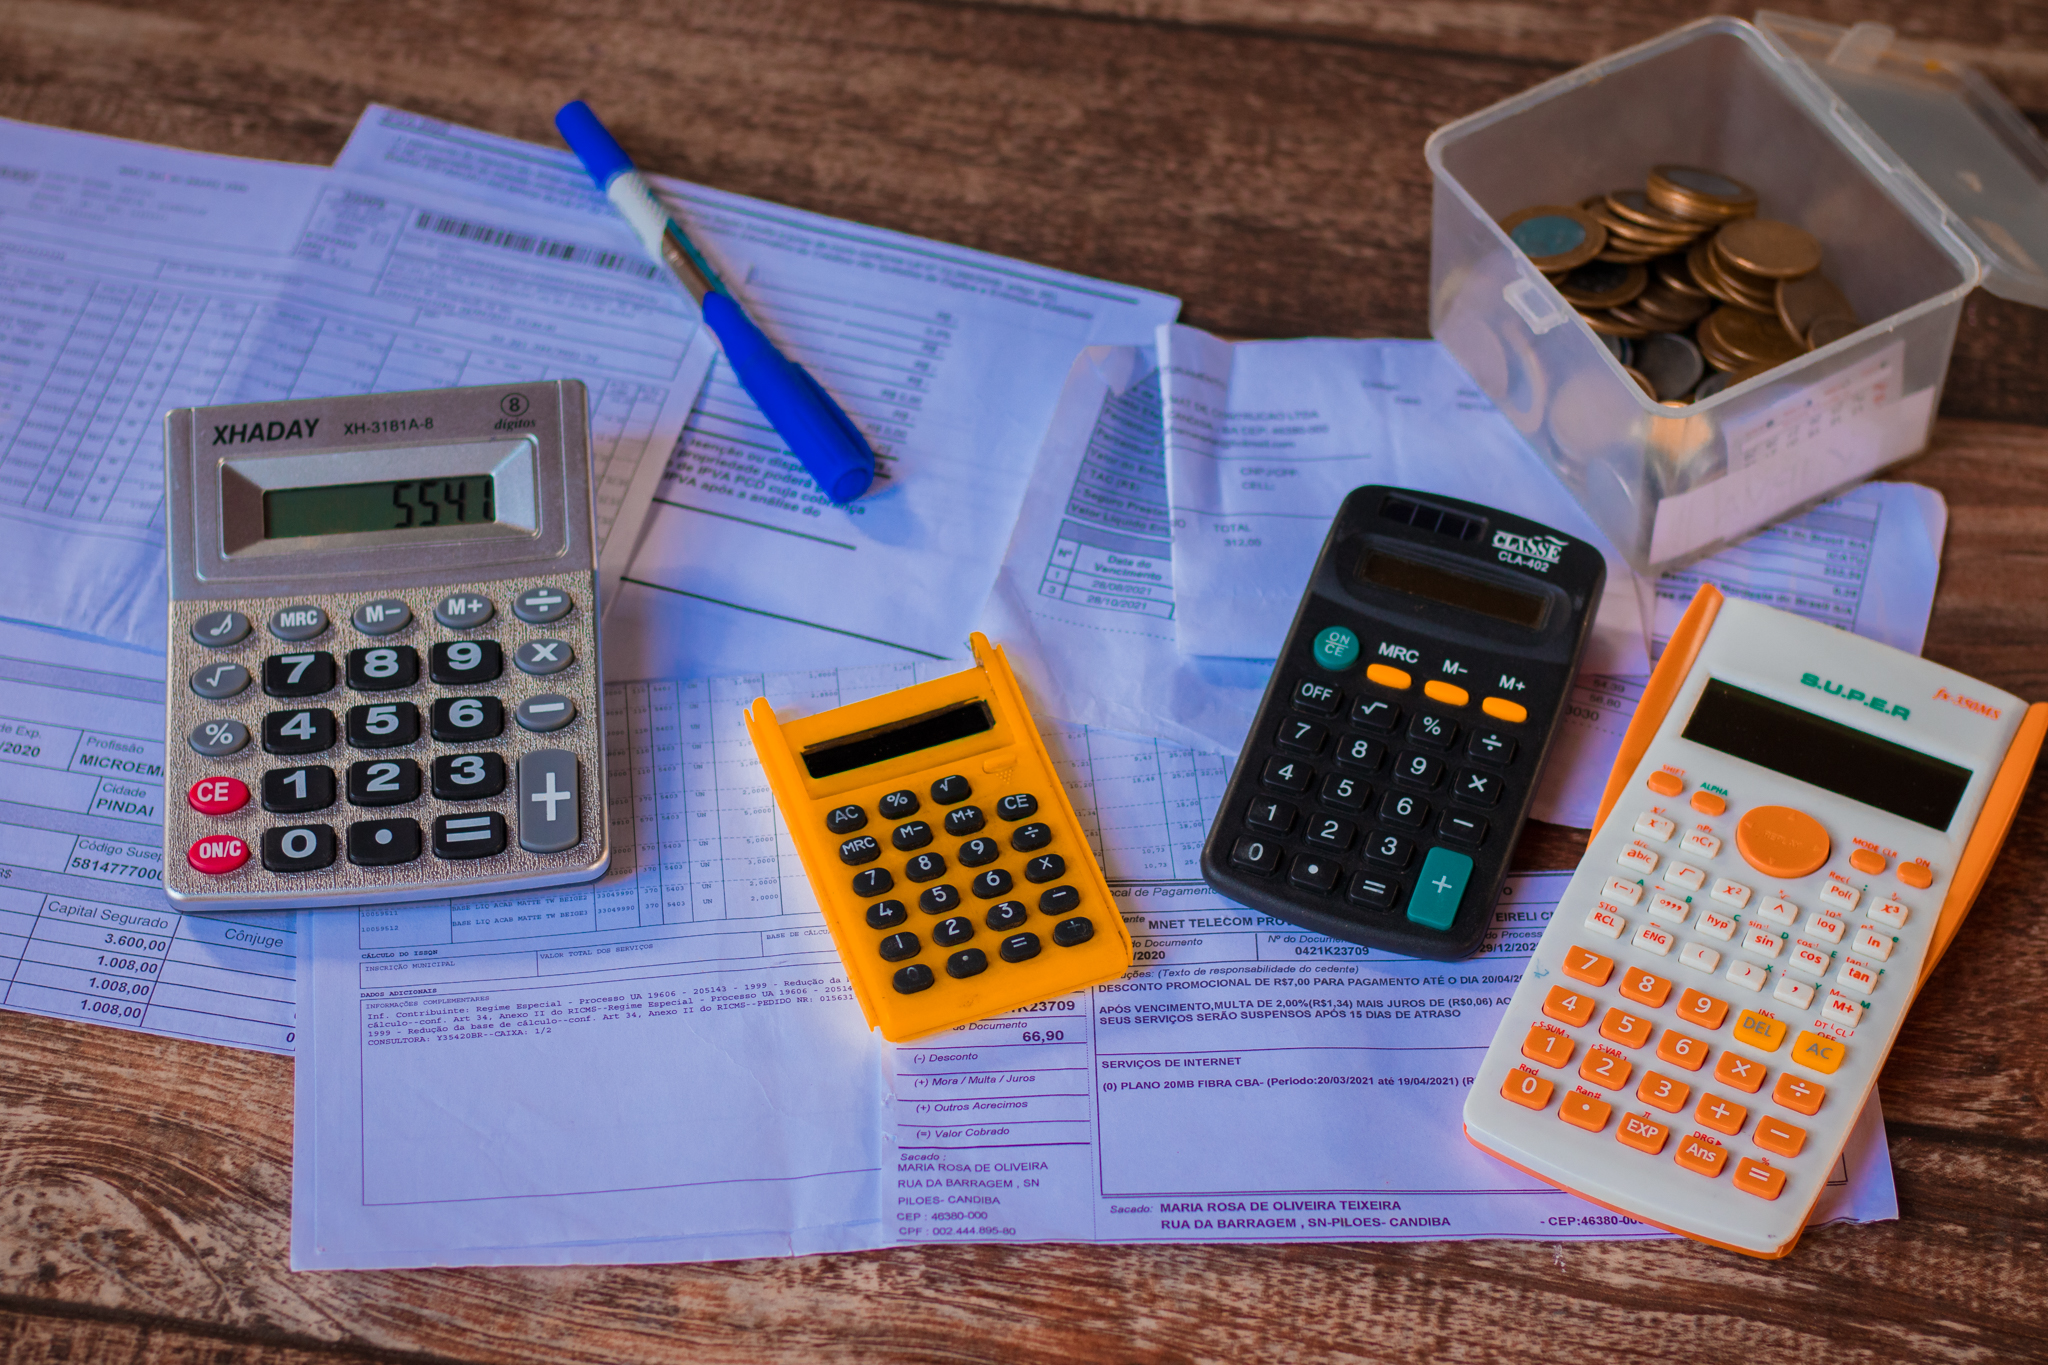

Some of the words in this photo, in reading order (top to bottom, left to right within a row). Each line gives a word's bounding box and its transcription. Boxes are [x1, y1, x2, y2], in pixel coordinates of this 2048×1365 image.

[212, 418, 319, 446] XHADAY
[344, 418, 434, 435] XH-3181A-8
[393, 477, 496, 529] 5541
[1498, 551, 1549, 572] CLA-402
[280, 610, 317, 627] MRC
[448, 598, 482, 616] M+
[1329, 632, 1350, 645] ON
[1325, 644, 1343, 657] CE
[281, 654, 315, 684] 7
[363, 649, 399, 678] 8
[447, 642, 482, 671] 9
[1378, 642, 1419, 664] MRC
[1499, 675, 1525, 691] M+
[1302, 683, 1333, 701] OFF
[280, 712, 316, 741] 4
[365, 706, 399, 735] 5
[448, 699, 485, 728] 6
[197, 781, 229, 802] CE
[282, 770, 307, 799] 1
[366, 764, 400, 793] 2
[450, 755, 486, 786] 3
[1662, 764, 1686, 776] SHIFT
[1700, 782, 1728, 796] ALPHA
[103, 783, 147, 798] Cidade
[96, 798, 154, 817] PINDAI
[834, 807, 859, 823] AC
[1004, 795, 1029, 810] CE
[79, 839, 122, 856] Código
[200, 840, 241, 860] ON/C
[281, 829, 317, 859] 0
[842, 837, 875, 856] MRC
[1852, 837, 1879, 853] MODE
[1882, 848, 1897, 858] CLR
[1915, 858, 1931, 868] ON
[48, 900, 97, 918] Capital
[100, 909, 168, 929] Segurado
[1598, 901, 1618, 913] STO
[1148, 920, 1185, 930] MNET
[1189, 917, 1253, 928] TELECOM
[1496, 912, 1536, 922] EIRELI
[1707, 914, 1728, 929] hyp
[1594, 912, 1615, 928] RCL
[1643, 930, 1666, 945] ENG
[1817, 918, 1836, 933] log
[105, 933, 166, 951] 3.600,00
[224, 927, 284, 948] Cônjuge
[1145, 938, 1203, 948] Documento
[1755, 935, 1773, 947] sin
[1295, 946, 1369, 956] 0421K23709
[1800, 951, 1822, 964] cos
[98, 954, 158, 974] 1.008,00
[1209, 965, 1296, 976] responsabilidade
[1314, 965, 1359, 974] cedente)
[1849, 968, 1870, 983] tan
[89, 976, 150, 996] 1.008,00
[1098, 982, 1163, 993] DESCONTO
[1166, 978, 1251, 990] PROMOCIONAL
[1255, 978, 1271, 987] DE
[1273, 978, 1310, 987] R$7,00
[1313, 978, 1344, 986] PARA
[1347, 977, 1420, 987] PAGAMENTO
[1423, 975, 1445, 985] ATÉ
[1460, 976, 1479, 984] DIA
[396, 1008, 469, 1018] Contribuinte:
[476, 1004, 511, 1013] Regime
[516, 1001, 562, 1010] Especial
[580, 996, 625, 1004] Processo
[693, 986, 726, 995] 205143
[784, 979, 824, 987] Redução
[1099, 1002, 1131, 1015] APÓS
[1135, 1000, 1254, 1013] VENCIMENTO,MULTA
[1257, 999, 1273, 1008] DE
[1357, 1000, 1384, 1009] MAIS
[1387, 999, 1425, 1008] JUROS
[1429, 998, 1445, 1007] DE
[1448, 998, 1492, 1008] (R$0,06)
[80, 999, 142, 1019] 1.008,00
[1100, 1016, 1131, 1025] SEUS
[1134, 1013, 1193, 1025] SERVIÇOS
[1196, 1011, 1237, 1022] SERÃO
[1240, 1010, 1311, 1020] SUSPENSOS
[1315, 1007, 1347, 1018] APÓS
[1350, 1010, 1362, 1019] 15
[1366, 1010, 1392, 1019] DIAS
[1395, 1010, 1411, 1019] DE
[1414, 1009, 1461, 1019] ATRASO
[969, 1021, 1028, 1031] Documento
[1743, 1016, 1771, 1037] DEL
[368, 1036, 430, 1046] CONSULTORA:
[1022, 1030, 1064, 1044] 66,90
[929, 1052, 978, 1063] Desconto
[1806, 1043, 1833, 1059] AC
[1102, 1059, 1161, 1070] SERVIÇOS
[1165, 1059, 1181, 1067] DE
[1184, 1057, 1241, 1067] INTERNET
[932, 1077, 958, 1086] Mora
[968, 1075, 998, 1085] Multa
[1006, 1074, 1035, 1083] Juros
[1121, 1081, 1160, 1090] PLANO
[1163, 1080, 1194, 1089] 20MB
[1198, 1079, 1232, 1088] FIBRA
[1235, 1078, 1264, 1087] CBA-
[1378, 1077, 1395, 1086] até
[1398, 1077, 1458, 1087] 19/04/2021)
[1519, 1063, 1539, 1075] Rnd
[1576, 1085, 1601, 1099] Ran#
[934, 1102, 970, 1112] Outros
[972, 1100, 1028, 1110] Acrecimos
[935, 1129, 963, 1139] Valor
[965, 1127, 1010, 1137] Cobrado
[1627, 1118, 1658, 1139] EXP
[1692, 1131, 1716, 1144] DRG
[1686, 1143, 1716, 1163] Ans
[898, 1163, 935, 1172] MARIA
[938, 1163, 972, 1172] ROSA
[975, 1164, 991, 1172] DE
[994, 1161, 1049, 1172] OLIVEIRA
[898, 1179, 923, 1188] RUA
[926, 1179, 942, 1188] DA
[946, 1179, 1013, 1189] BARRAGEM
[1023, 1178, 1040, 1187] SN
[948, 1195, 1001, 1205] CANDIBA
[1160, 1202, 1204, 1214] MARIA
[1207, 1201, 1247, 1213] ROSA
[1250, 1201, 1269, 1212] DE
[1272, 1200, 1335, 1212] OLIVEIRA
[1339, 1200, 1401, 1212] TEIXEIRA
[897, 1212, 921, 1221] CEP
[931, 1211, 988, 1221] 46380-000
[1160, 1218, 1191, 1230] RUA
[1193, 1218, 1214, 1230] DA
[1217, 1217, 1297, 1230] BARRAGEM
[1307, 1216, 1386, 1228] SN-PILOES-
[1389, 1216, 1451, 1228] CANDIBA
[899, 1227, 922, 1236] CPF
[933, 1226, 1016, 1236] 002.444.895-80
